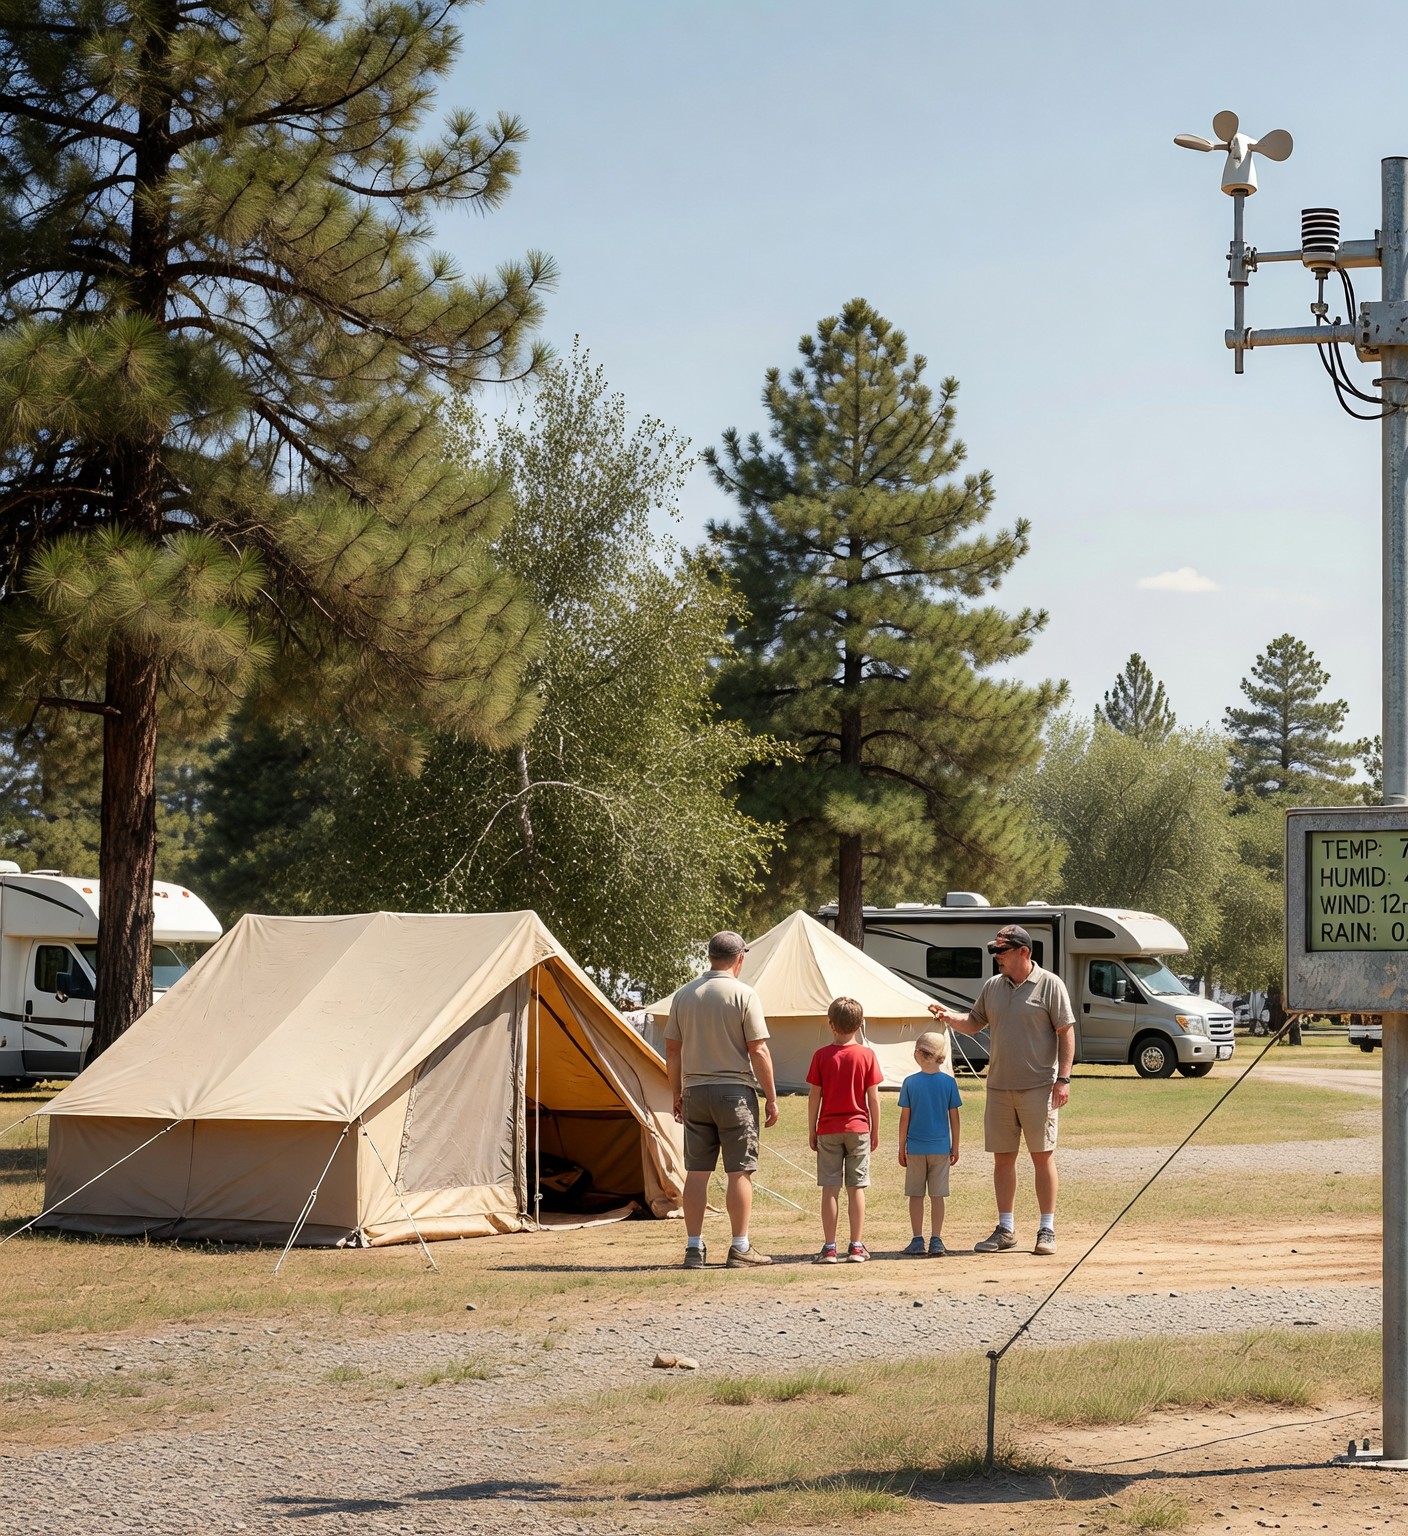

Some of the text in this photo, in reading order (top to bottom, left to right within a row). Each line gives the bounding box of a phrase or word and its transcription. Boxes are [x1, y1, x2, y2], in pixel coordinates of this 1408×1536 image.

[1322, 839, 1382, 859] TEMP:
[1321, 867, 1391, 887] HUMID:
[1320, 895, 1375, 914] WIND:
[1322, 922, 1376, 942] RAIN:
